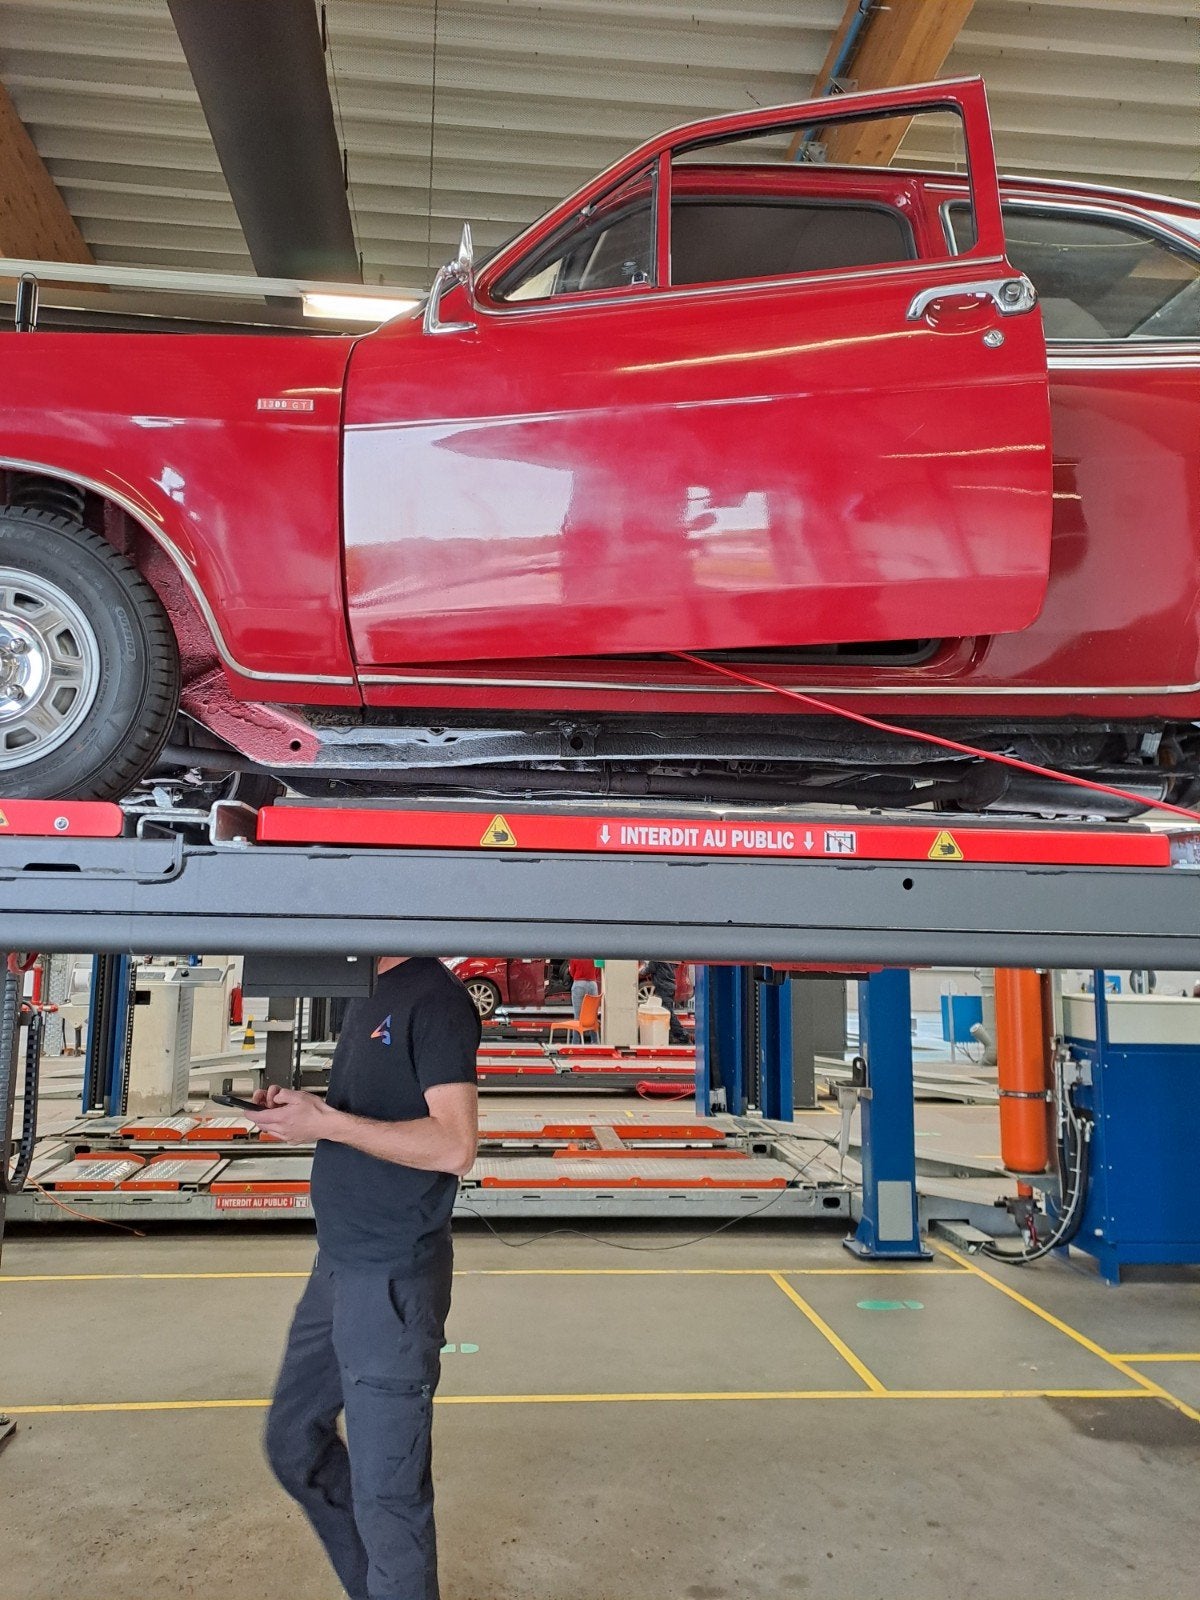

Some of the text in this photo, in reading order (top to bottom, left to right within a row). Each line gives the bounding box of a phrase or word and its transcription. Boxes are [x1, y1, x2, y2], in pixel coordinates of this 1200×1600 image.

[292, 401, 307, 410] GT
[620, 826, 795, 850] INTERDIT AU PUBLIC
[221, 1197, 288, 1208] INTERDIT AU PUBLIC
